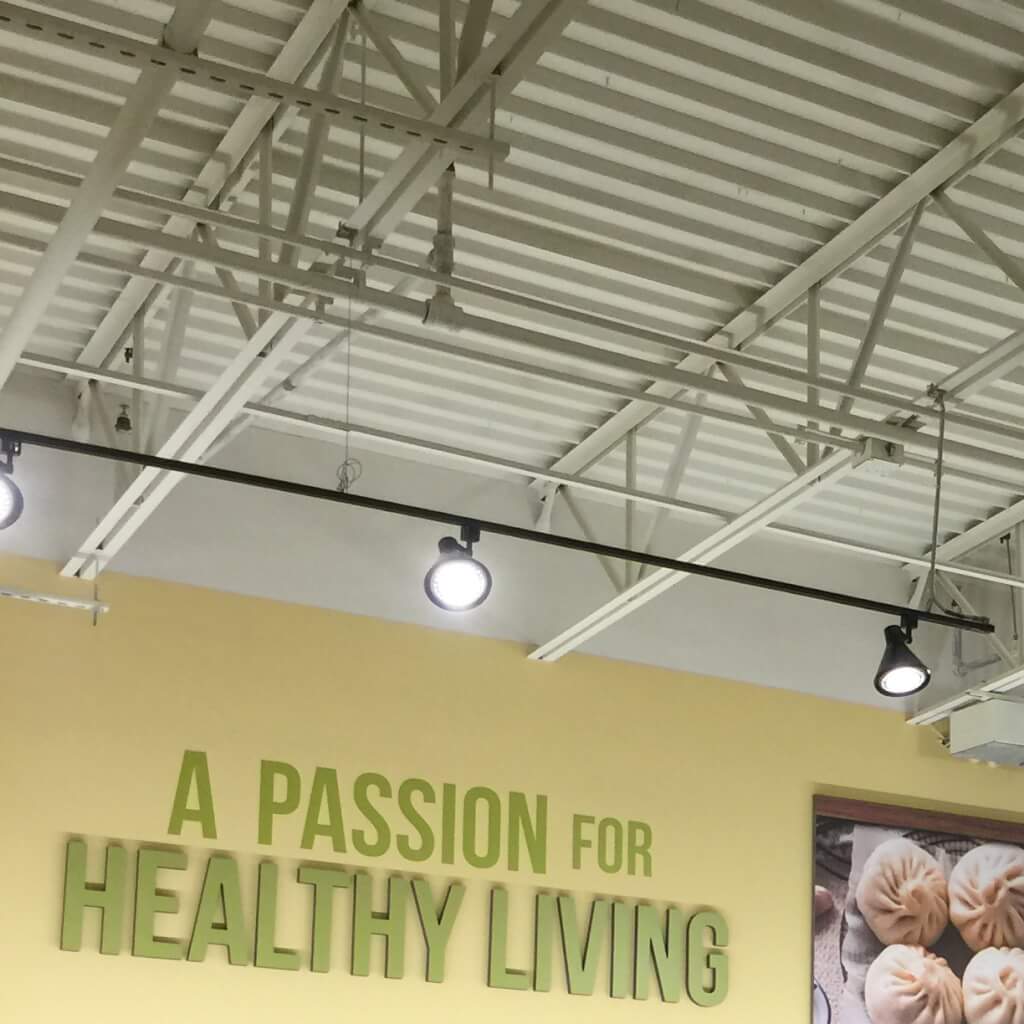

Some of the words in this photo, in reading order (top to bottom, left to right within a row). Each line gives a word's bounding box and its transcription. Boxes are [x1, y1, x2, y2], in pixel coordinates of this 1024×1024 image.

[167, 749, 218, 840] A
[257, 759, 548, 875] PASSION
[572, 813, 653, 877] FOR
[60, 836, 467, 983] HEALTHY
[487, 886, 729, 1008] LIVING
